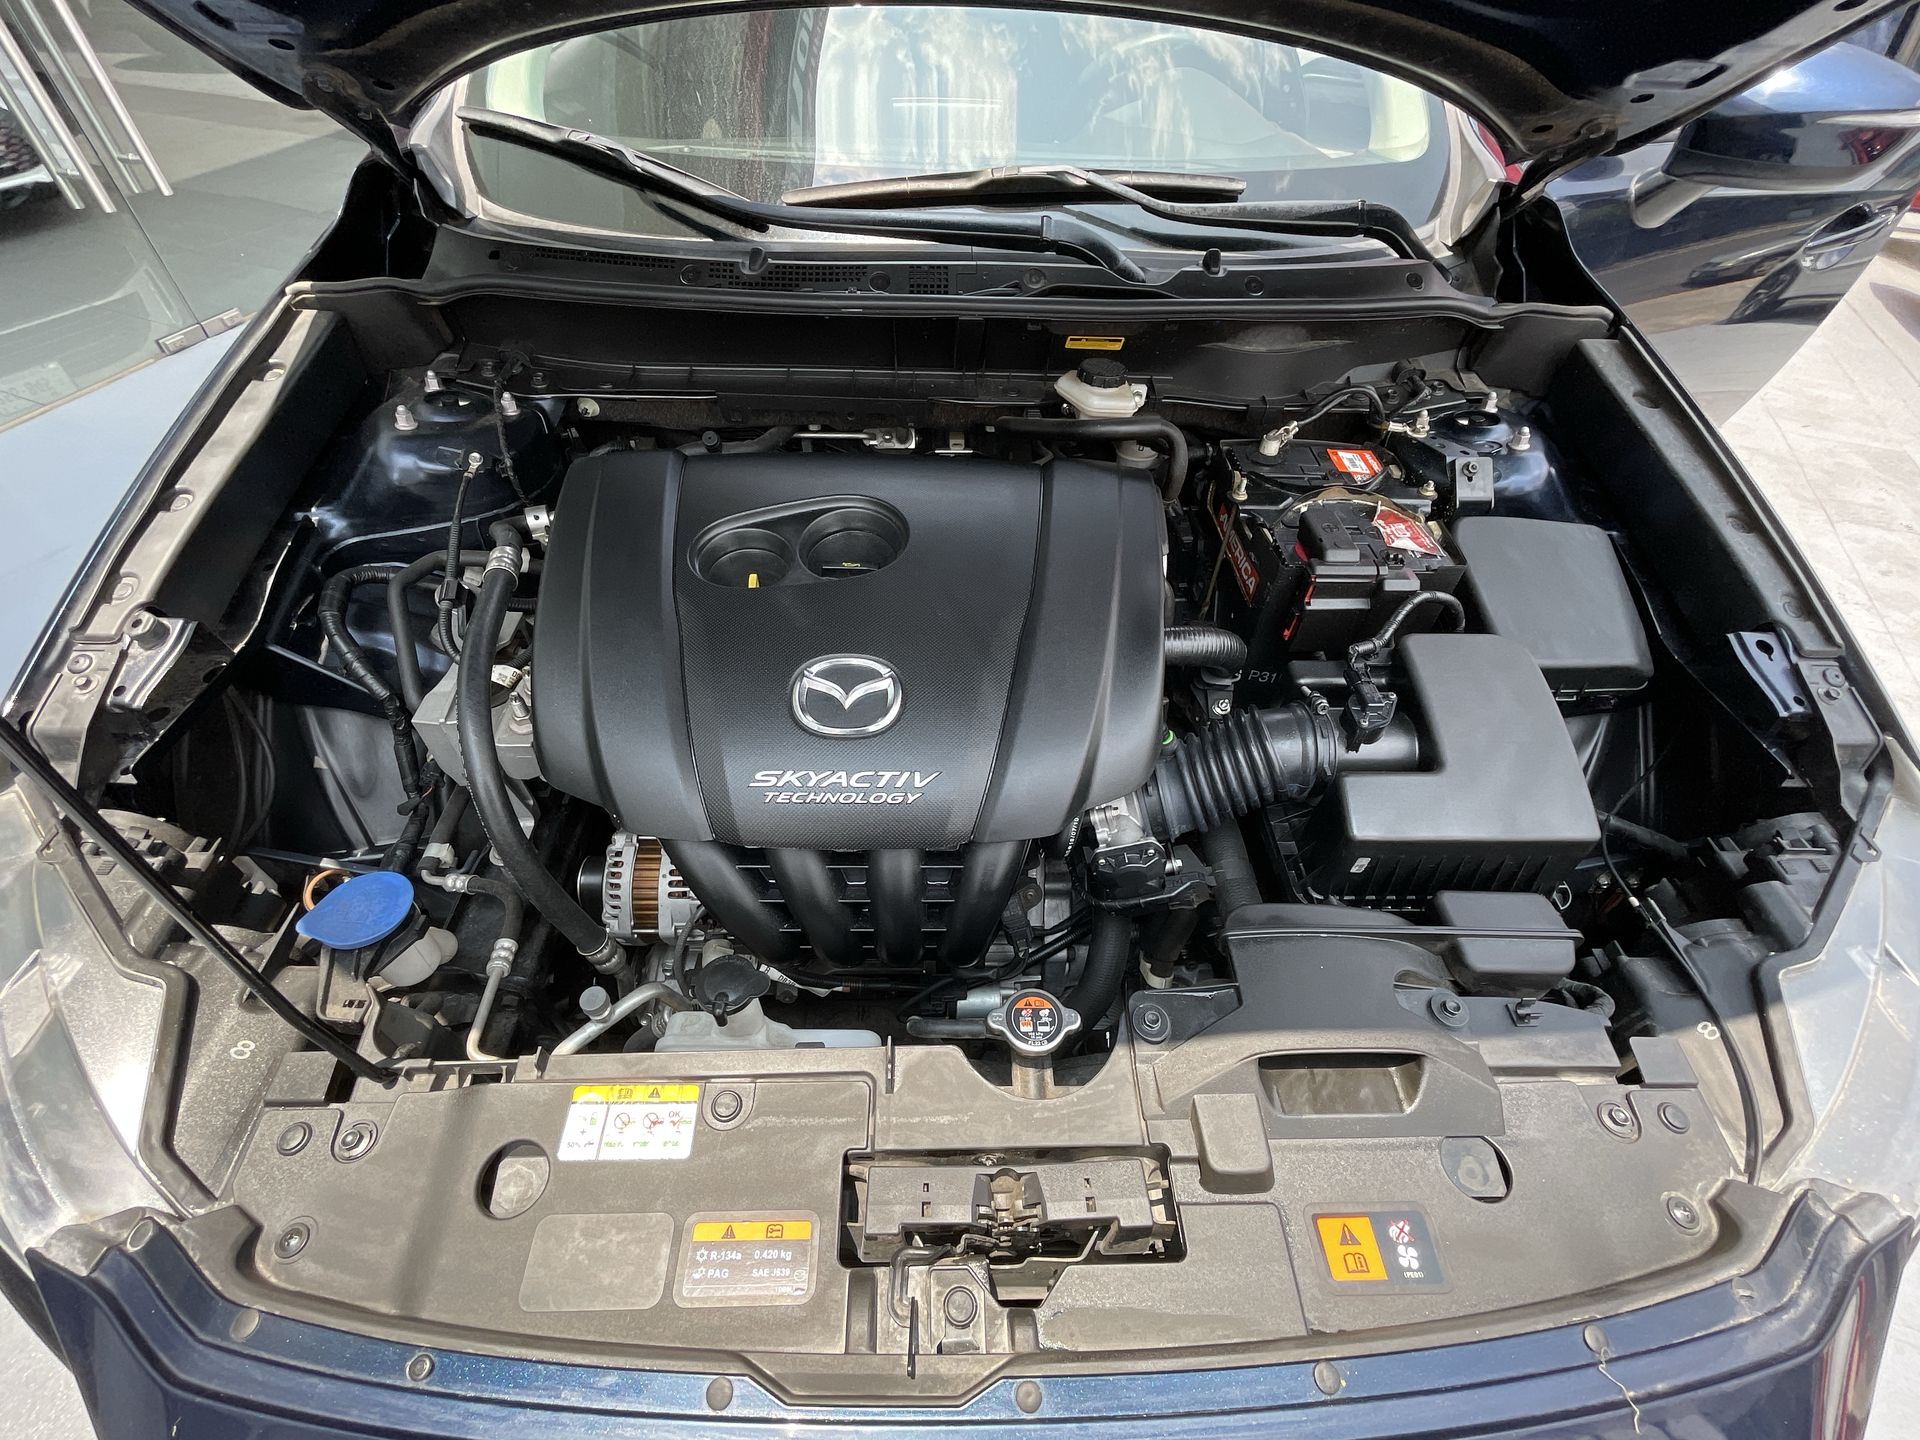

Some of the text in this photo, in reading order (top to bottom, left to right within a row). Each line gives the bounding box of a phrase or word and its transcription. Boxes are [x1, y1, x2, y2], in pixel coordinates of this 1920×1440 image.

[749, 770, 942, 788] SKYACTIV
[764, 792, 923, 804] TECHNOLOGY
[230, 1040, 256, 1059] 8
[668, 1110, 681, 1118] OK
[710, 1249, 792, 1261] R-134a 0.420 kg
[707, 1268, 729, 1278] PAG
[752, 1268, 769, 1277] SAE
